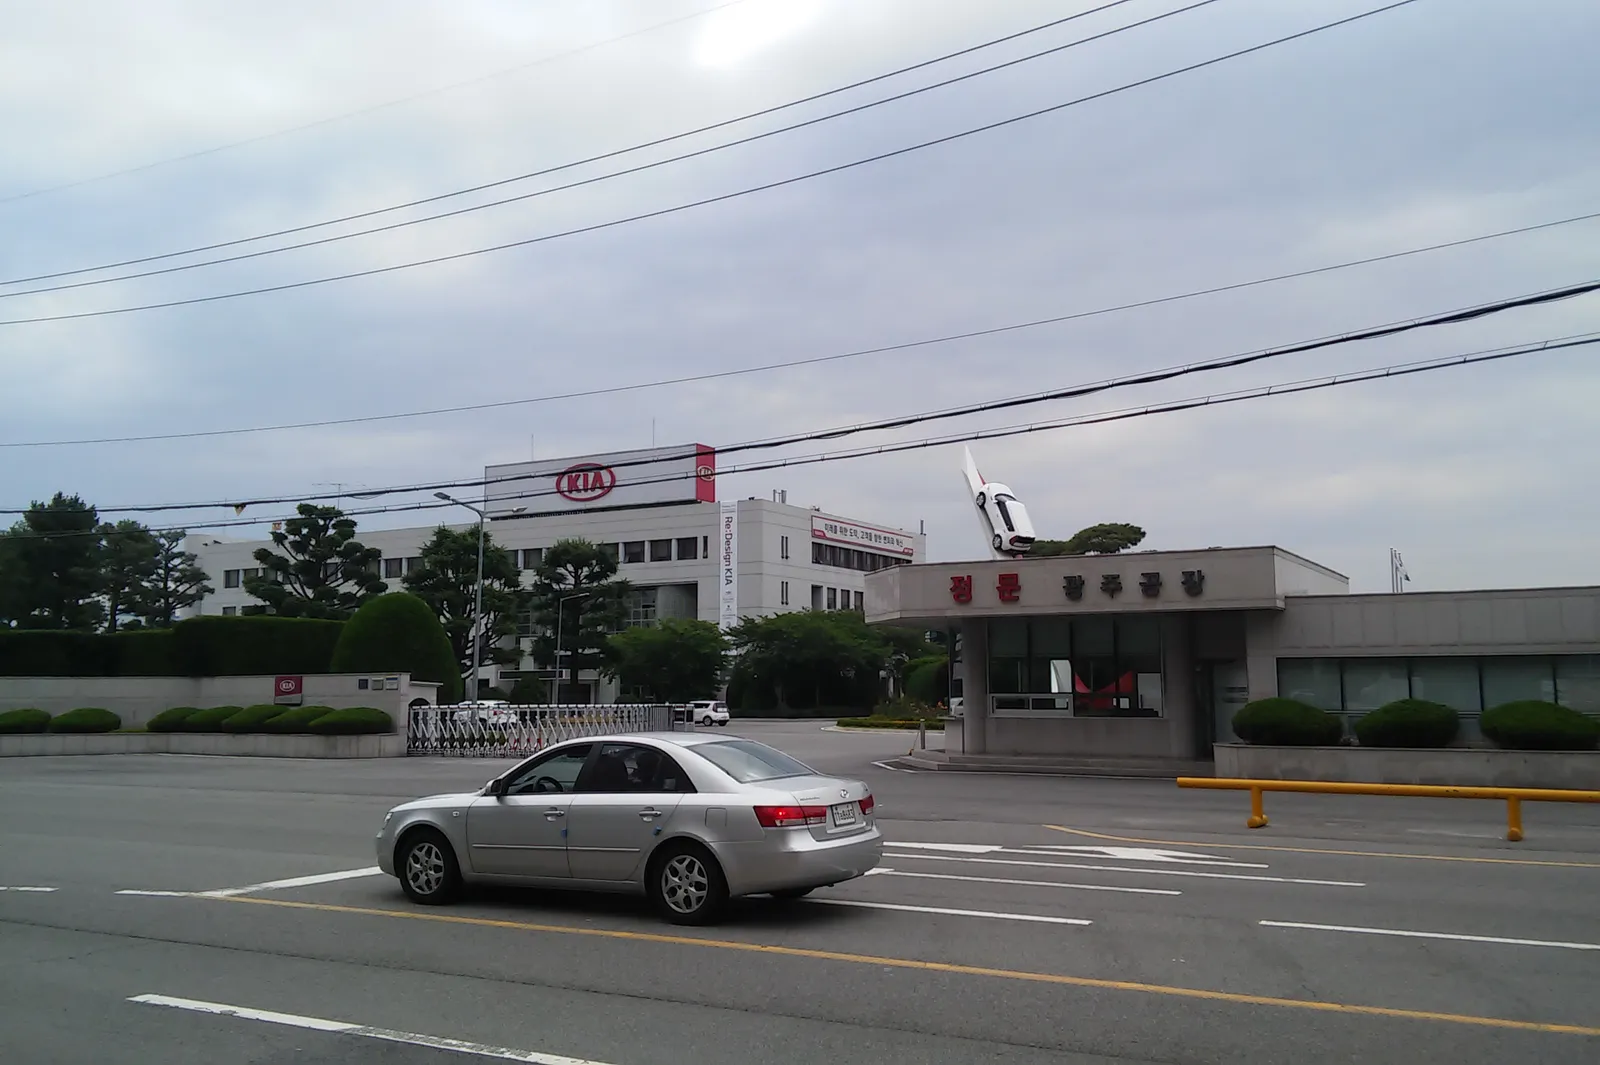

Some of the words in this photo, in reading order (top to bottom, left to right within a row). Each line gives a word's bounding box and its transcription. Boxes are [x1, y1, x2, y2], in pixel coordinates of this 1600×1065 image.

[567, 472, 605, 494] KIA
[723, 516, 733, 567] Re:Design
[725, 568, 733, 586] KIA
[949, 573, 1021, 603] 정문
[1062, 569, 1205, 600] 광주공장
